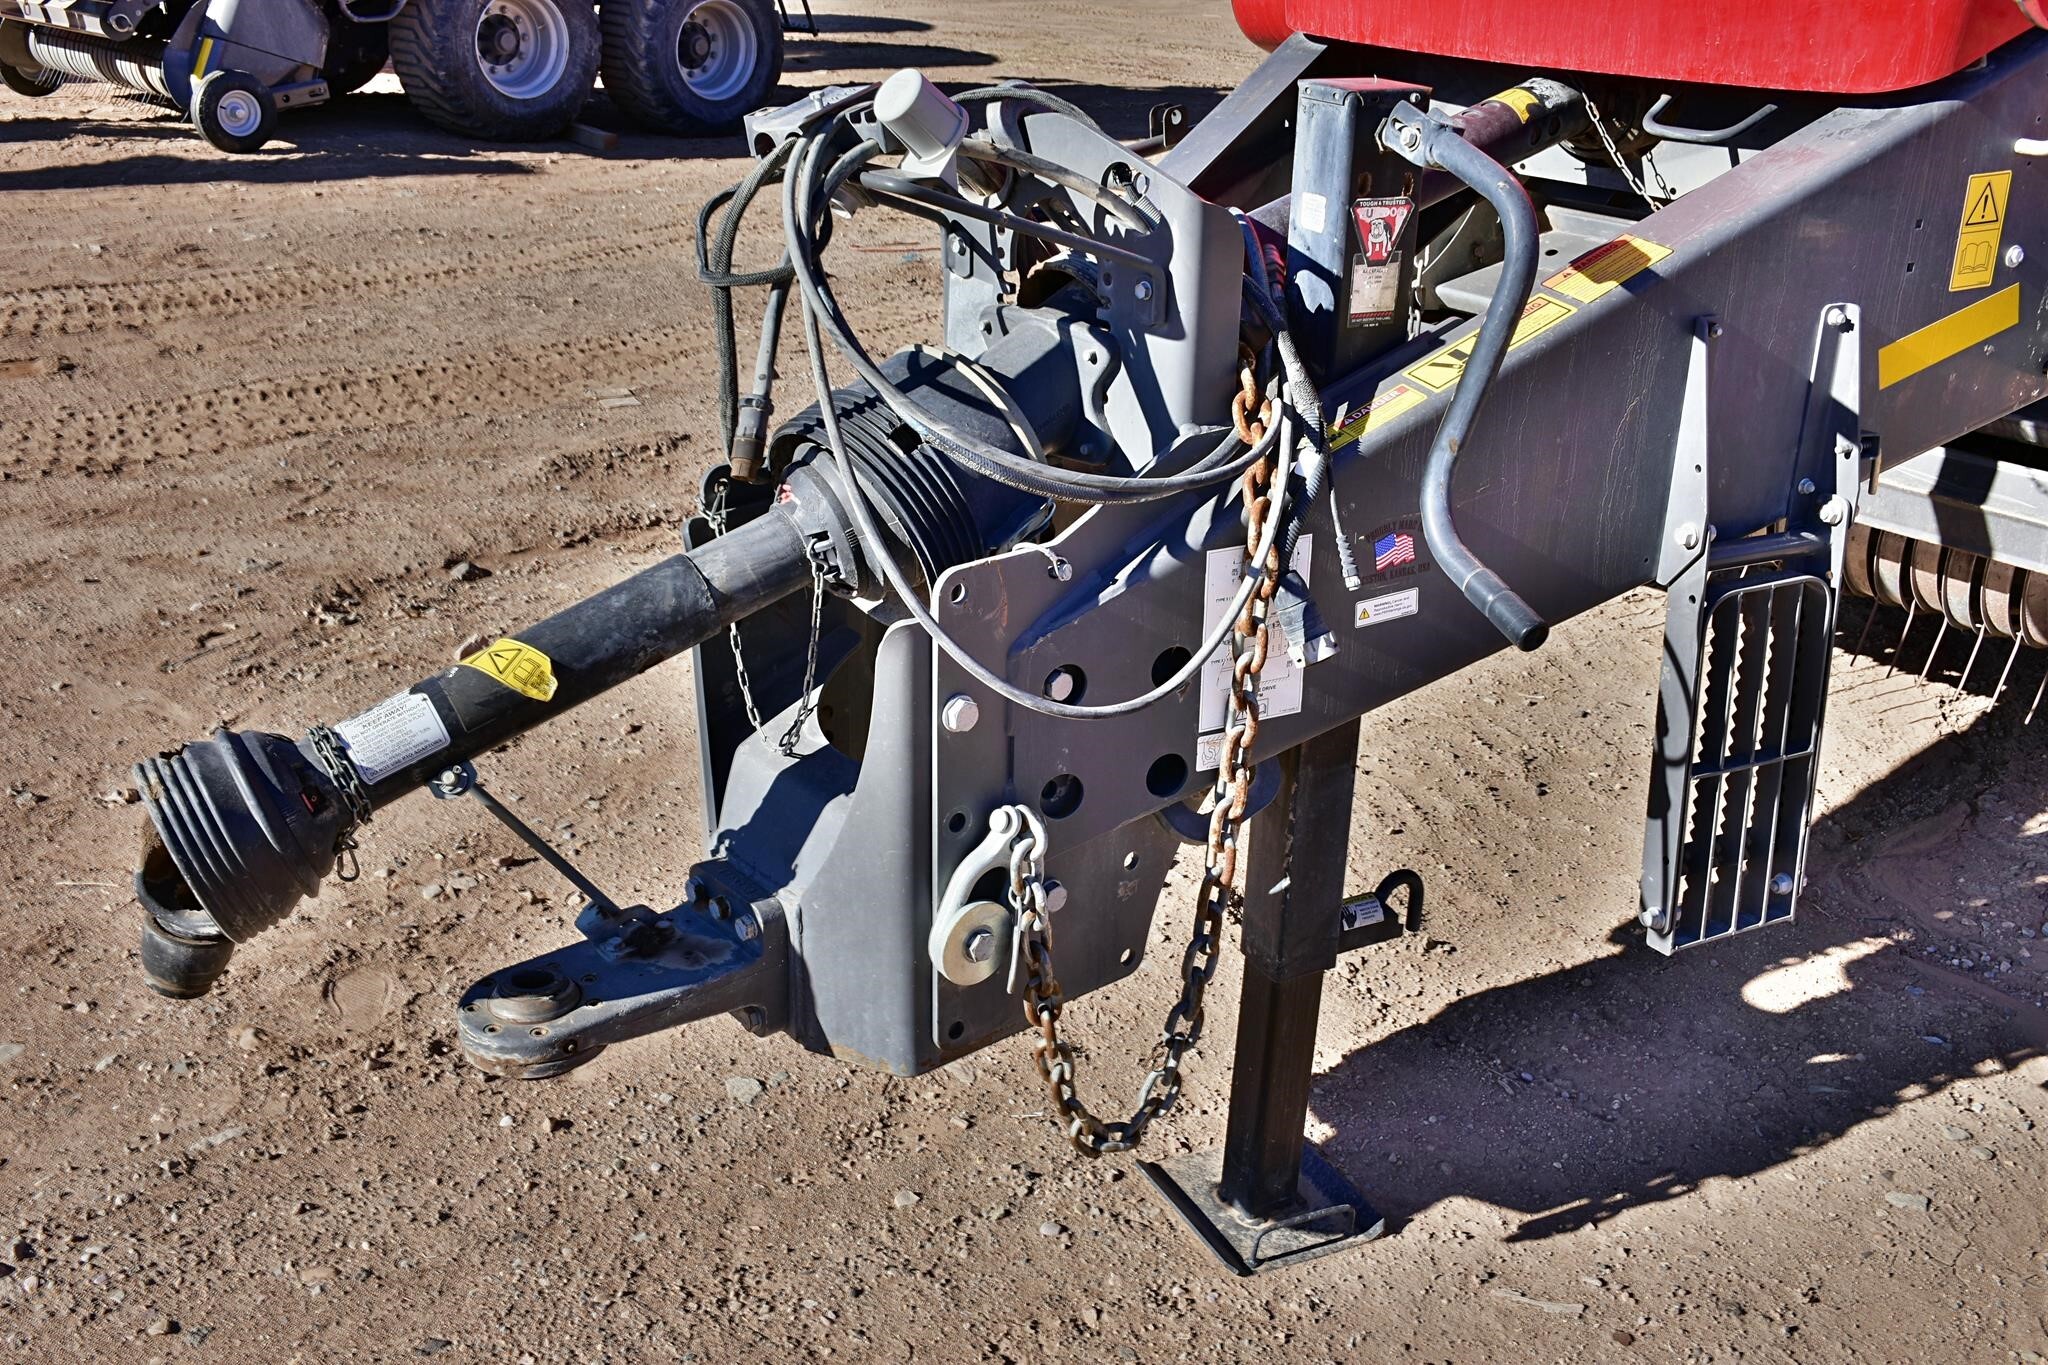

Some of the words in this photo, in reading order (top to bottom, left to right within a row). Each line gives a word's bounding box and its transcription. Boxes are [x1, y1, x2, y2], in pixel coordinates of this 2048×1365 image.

[1352, 389, 1401, 418] DANGER
[1360, 571, 1387, 586] ESSTON,
[359, 727, 371, 735] NOT
[372, 716, 395, 729] OPERATE
[362, 716, 383, 729] KEEP
[383, 703, 407, 719] AWAY!
